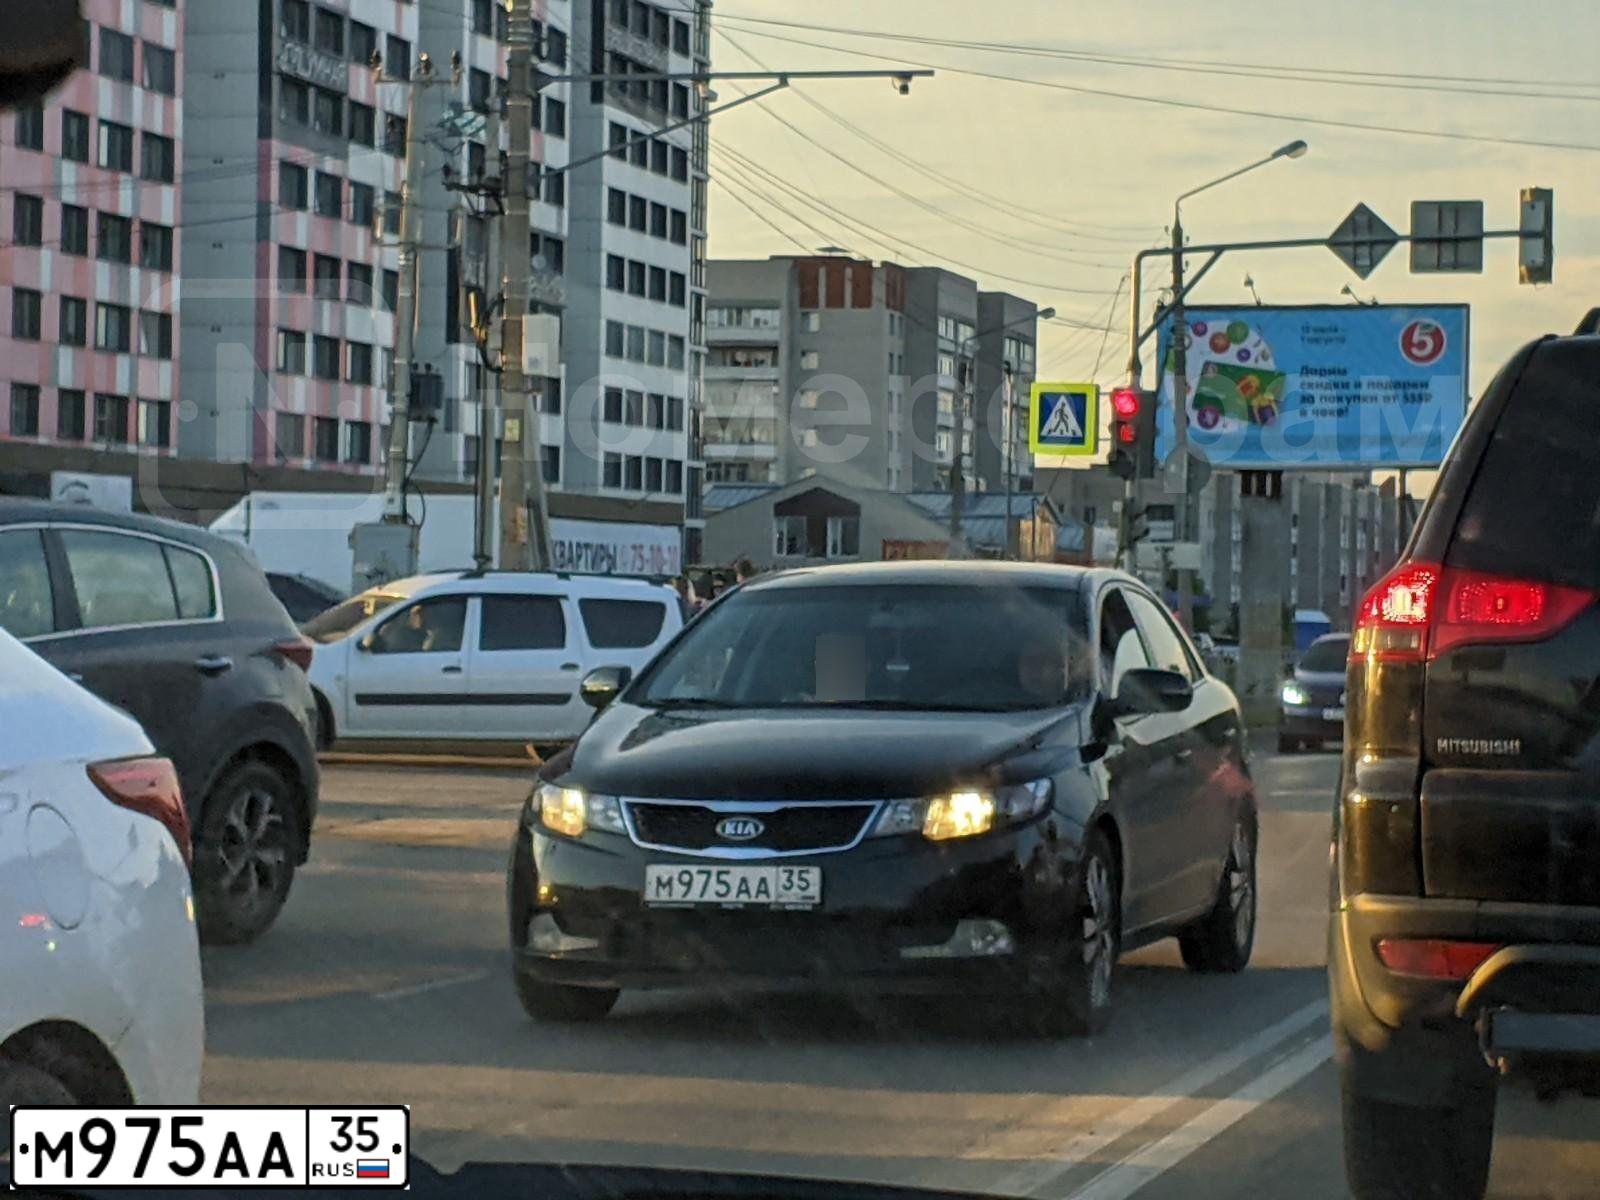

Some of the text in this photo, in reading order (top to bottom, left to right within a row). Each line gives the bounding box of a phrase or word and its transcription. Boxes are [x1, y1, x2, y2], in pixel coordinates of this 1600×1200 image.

[1437, 738, 1521, 754] MITSUBISHI
[725, 821, 757, 836] KIA
[656, 869, 770, 899] М975АА
[782, 868, 811, 892] 35
